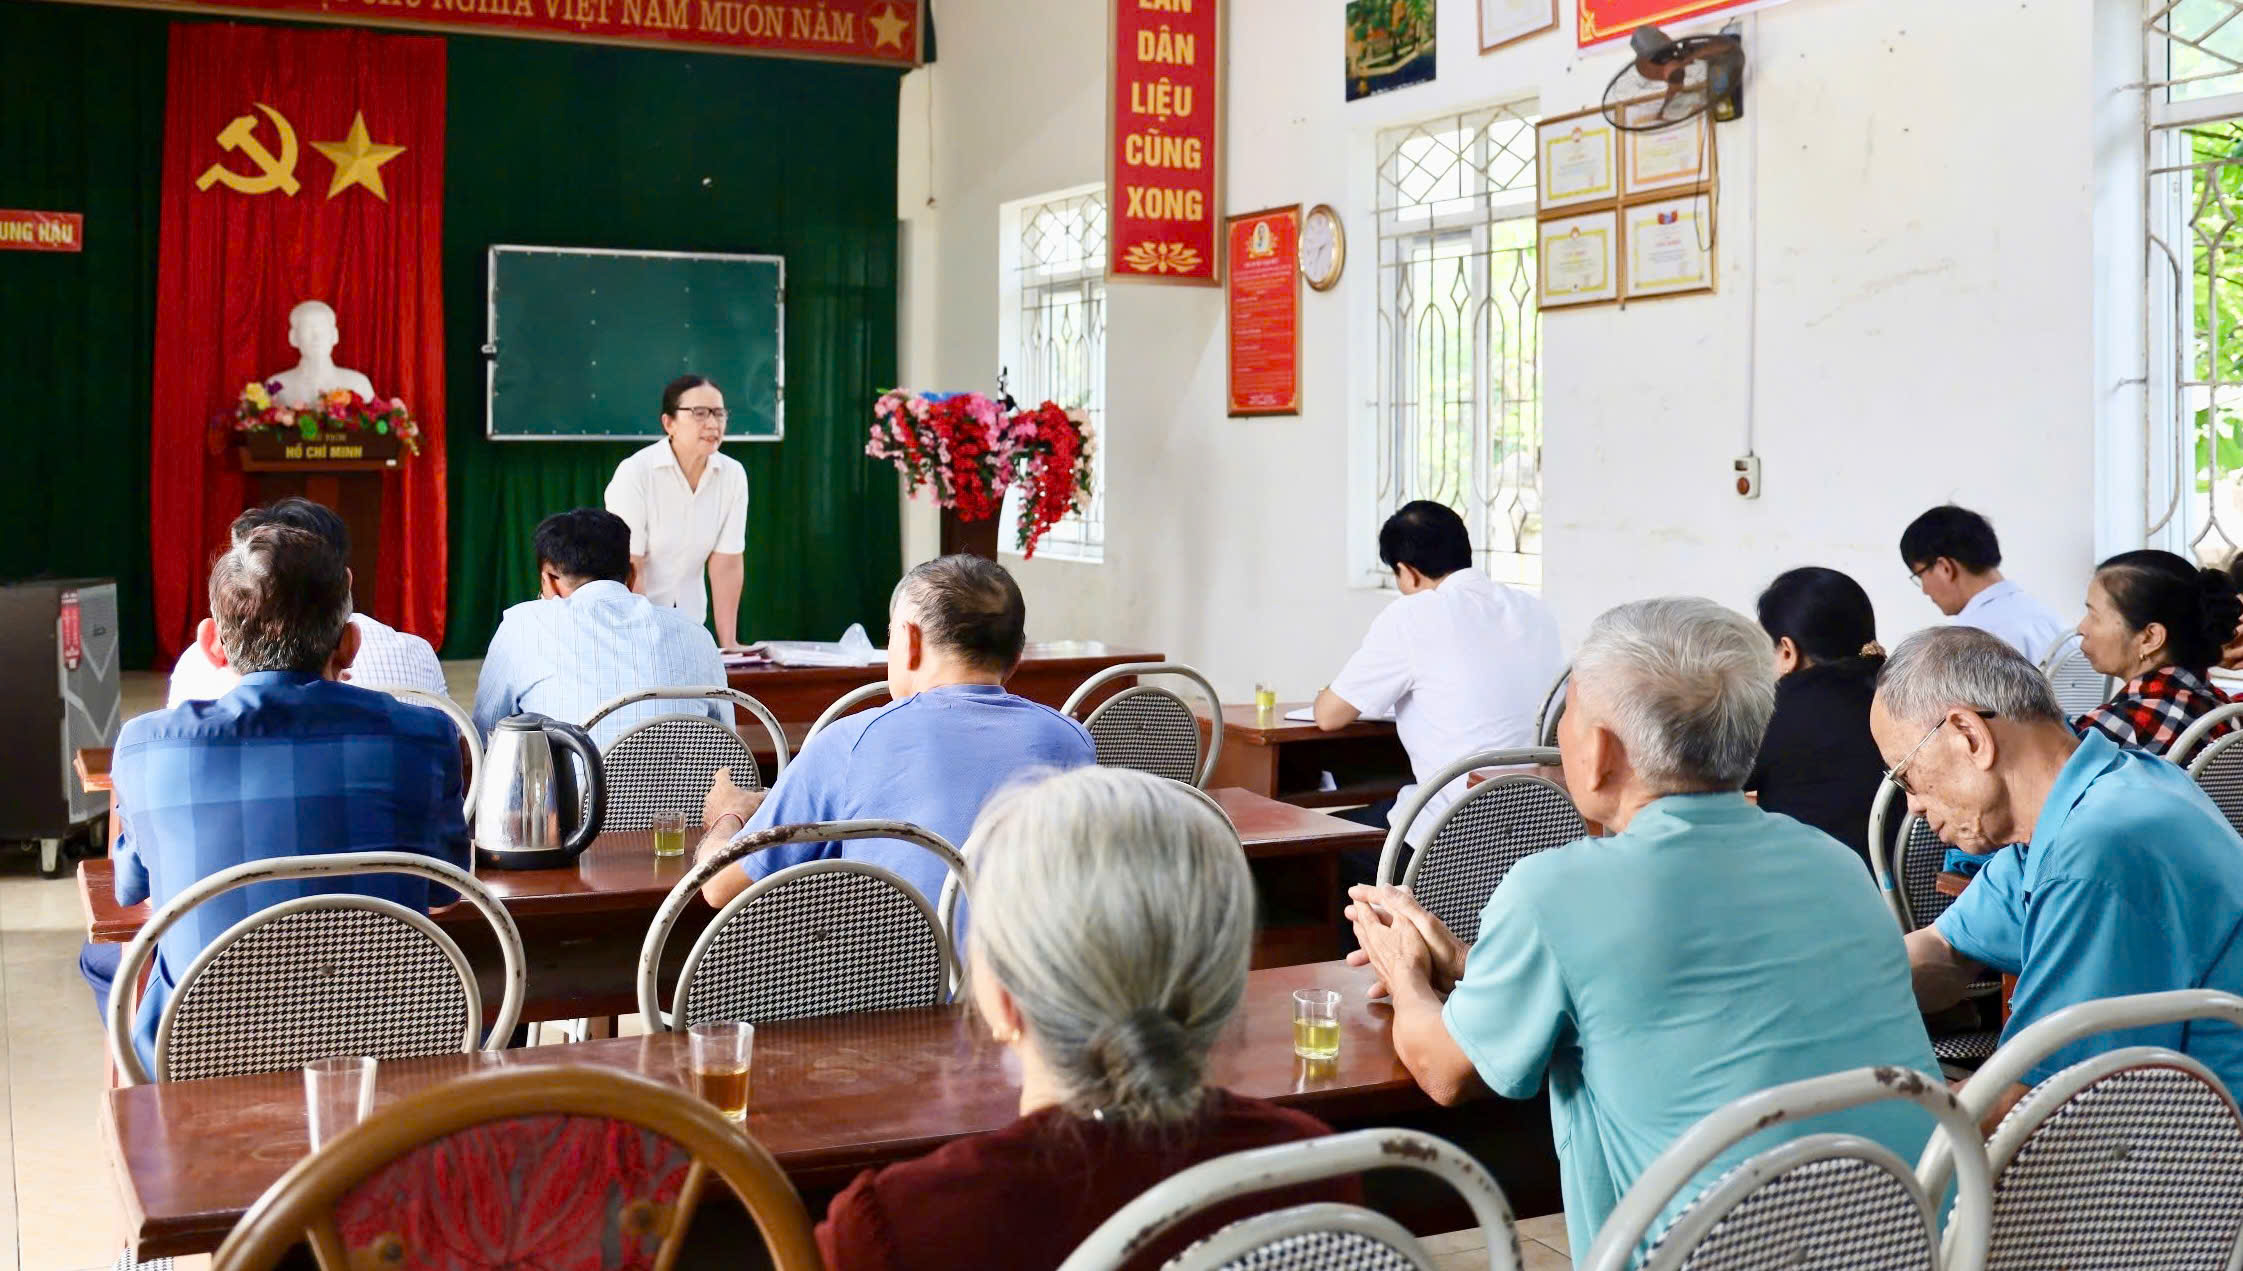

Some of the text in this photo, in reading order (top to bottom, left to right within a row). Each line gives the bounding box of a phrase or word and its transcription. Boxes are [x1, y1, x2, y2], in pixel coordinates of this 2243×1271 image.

[620, 0, 688, 30] NAM
[791, 1, 855, 43] NĂM
[1137, 24, 1195, 65] DÂN
[1131, 77, 1192, 122] LIỆU
[1125, 127, 1202, 170] CŨNG
[1126, 186, 1203, 221] XONG
